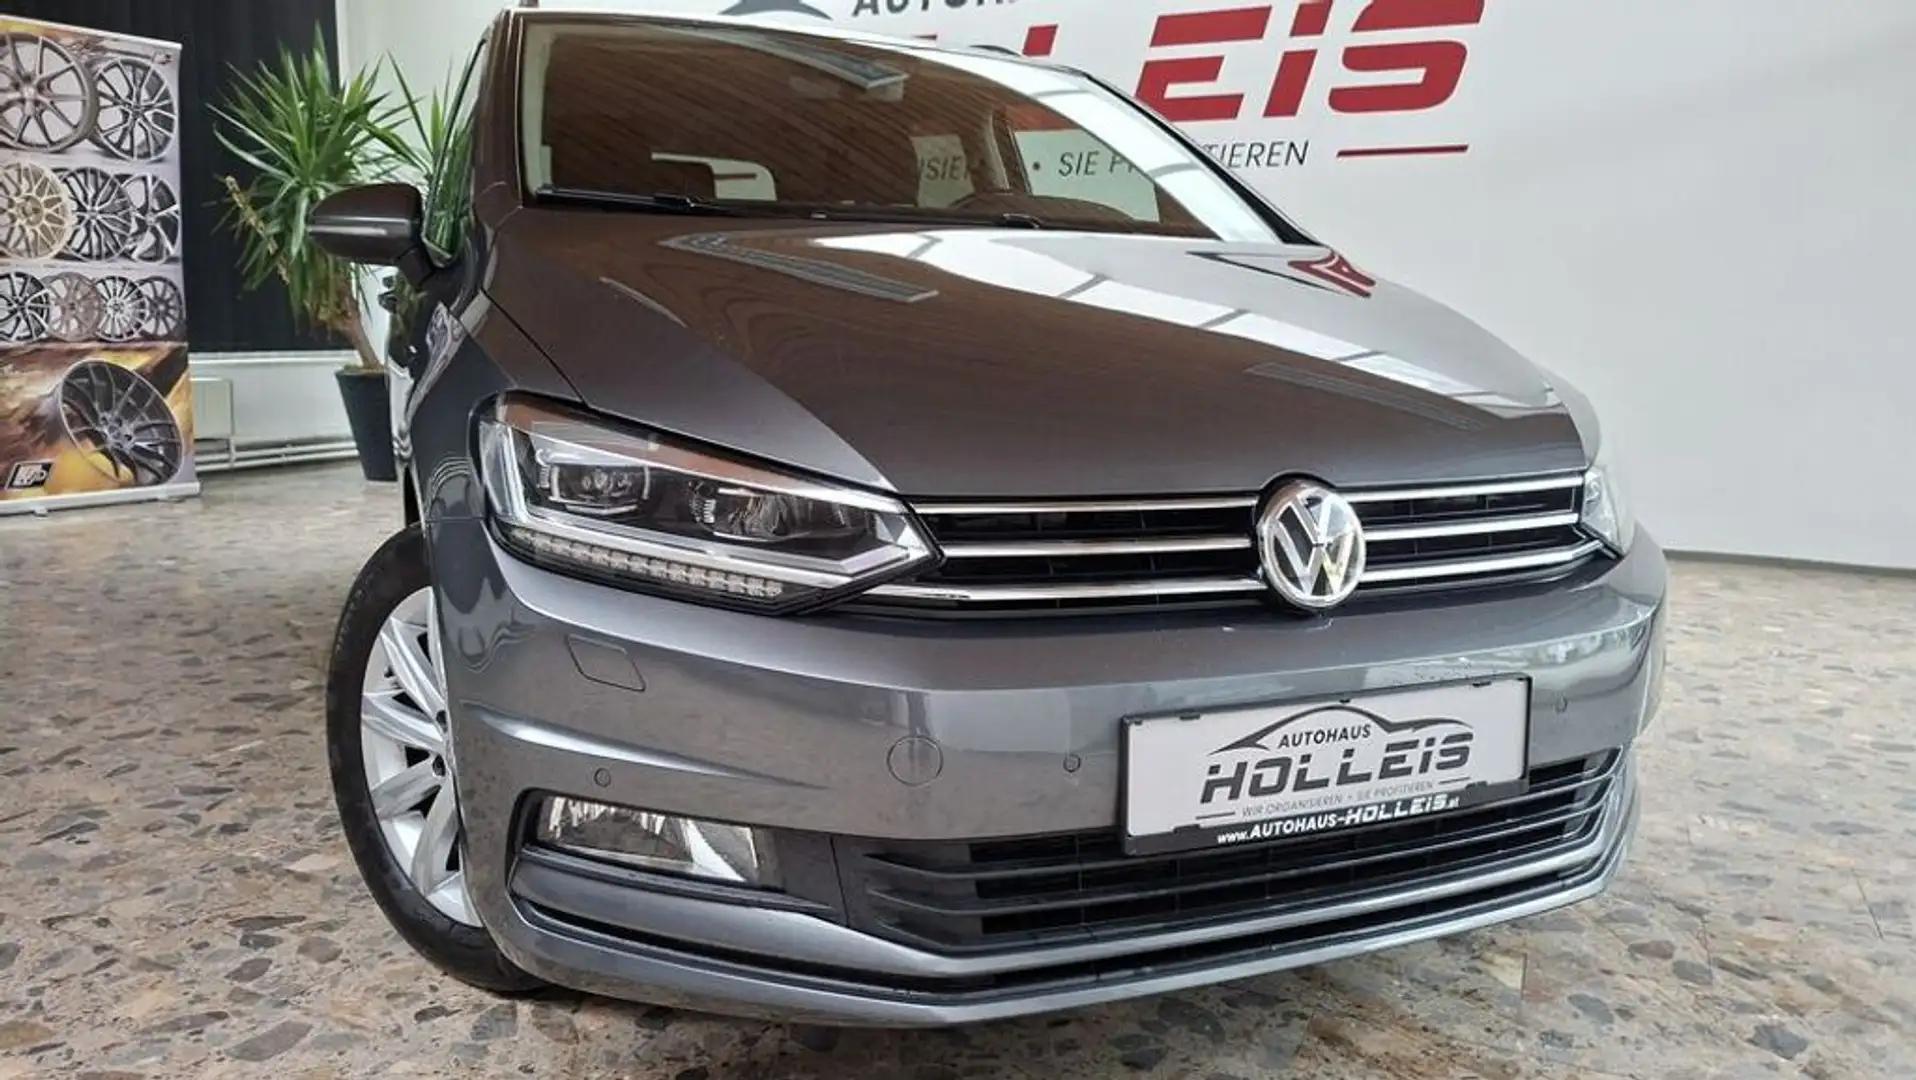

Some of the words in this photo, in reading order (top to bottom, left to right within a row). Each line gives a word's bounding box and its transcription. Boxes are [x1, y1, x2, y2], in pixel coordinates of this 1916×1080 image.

[1058, 150, 1099, 177] SIE
[1277, 724, 1372, 749] AUTOHAUS
[1200, 732, 1474, 804] HOLLEIS
